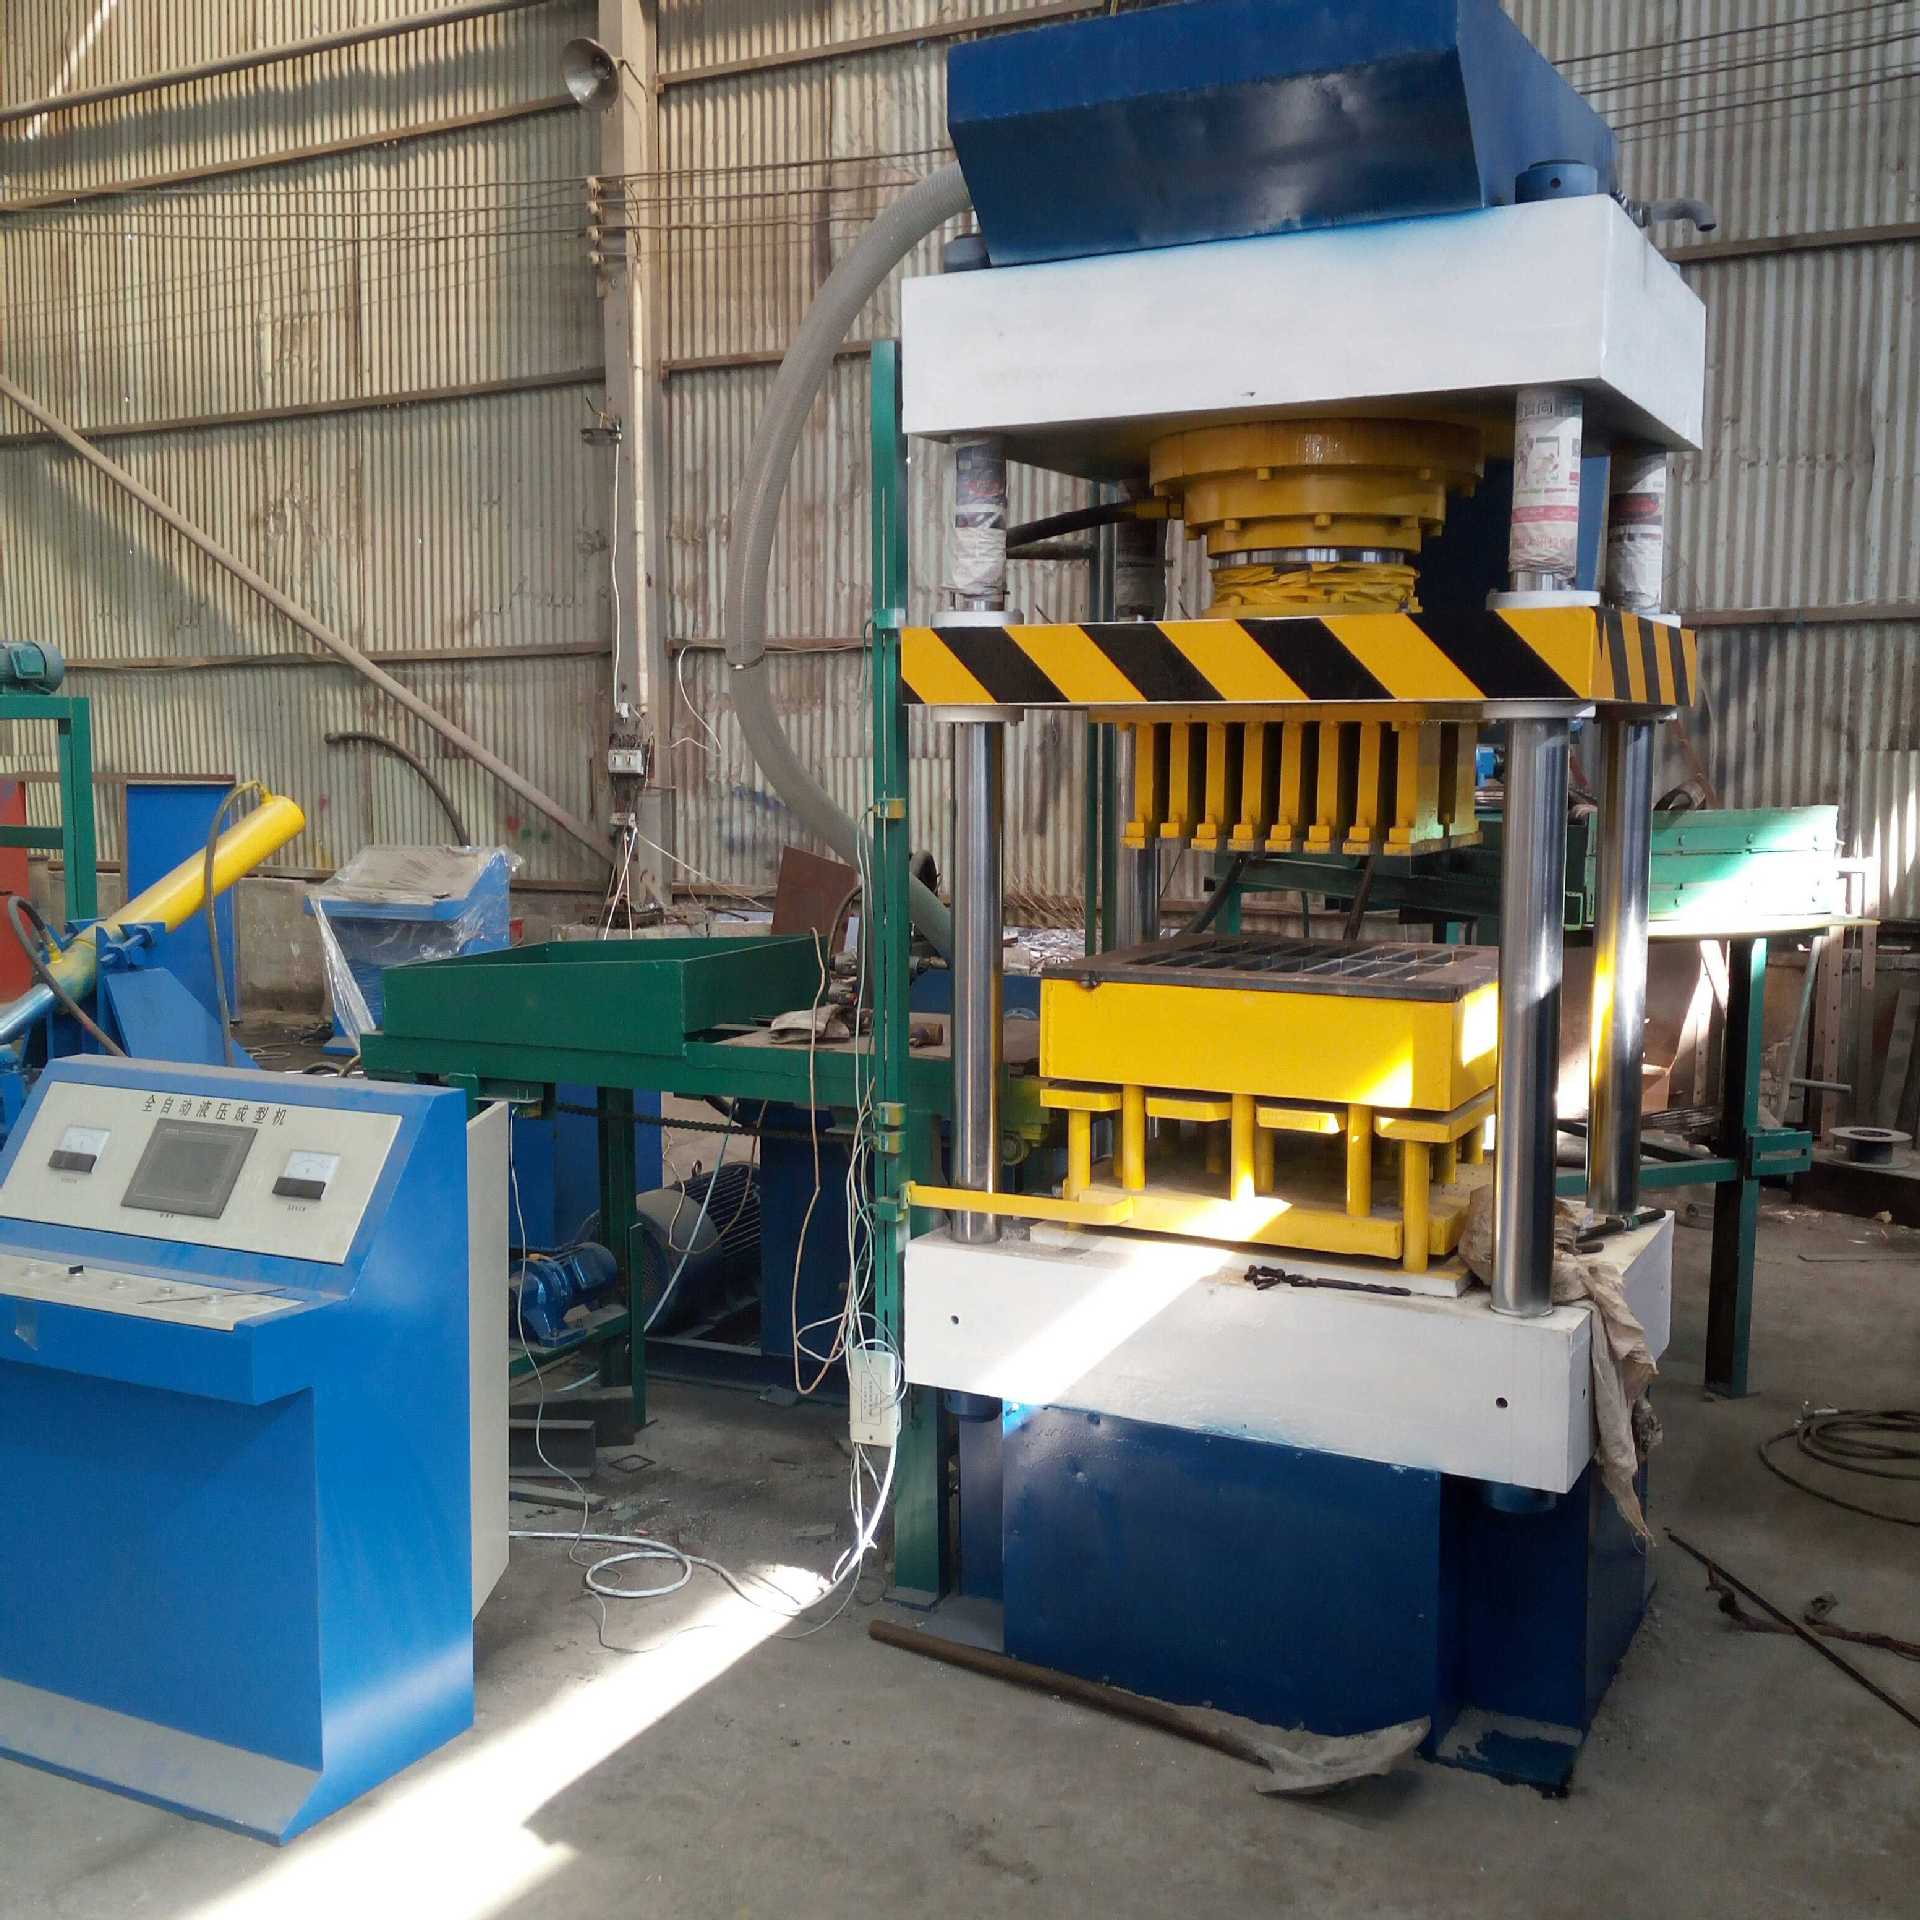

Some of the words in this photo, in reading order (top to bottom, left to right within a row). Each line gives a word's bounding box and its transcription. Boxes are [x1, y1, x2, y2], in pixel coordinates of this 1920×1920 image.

[142, 1095, 287, 1128] 全自动液压成型机
